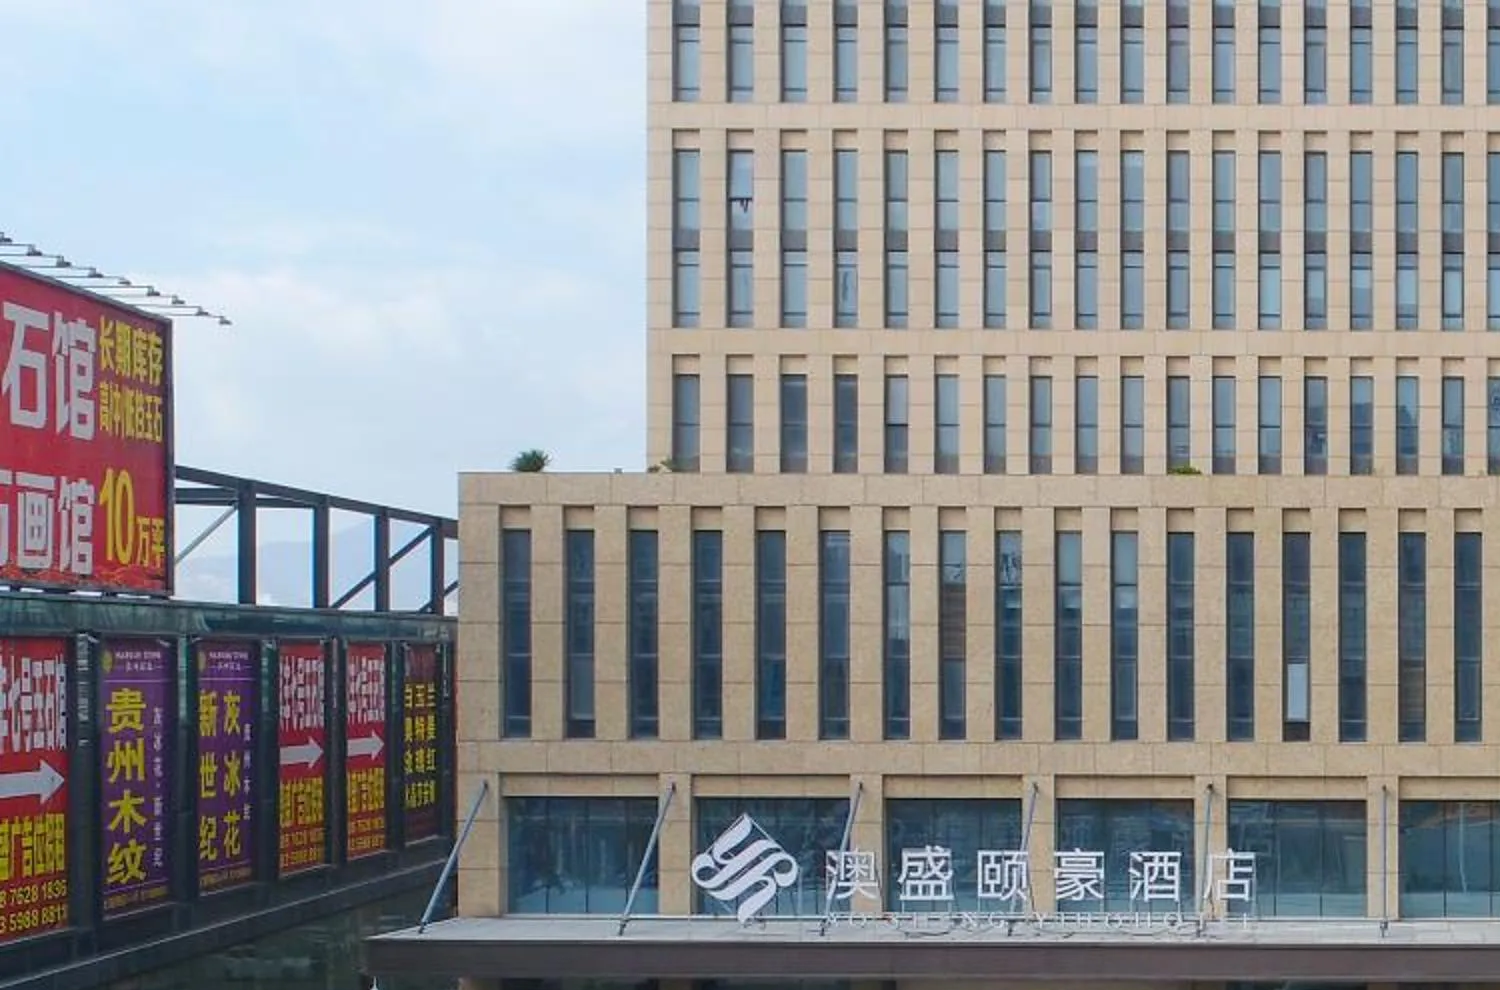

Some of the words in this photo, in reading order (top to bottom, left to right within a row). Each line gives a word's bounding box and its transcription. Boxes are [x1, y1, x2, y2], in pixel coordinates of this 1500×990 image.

[2, 301, 96, 441] 石馆
[99, 314, 163, 386] 长期库存
[105, 688, 147, 885] 贵州木纹
[199, 690, 219, 862] 新世纪
[825, 844, 1258, 903] 澳盛颐豪酒店
